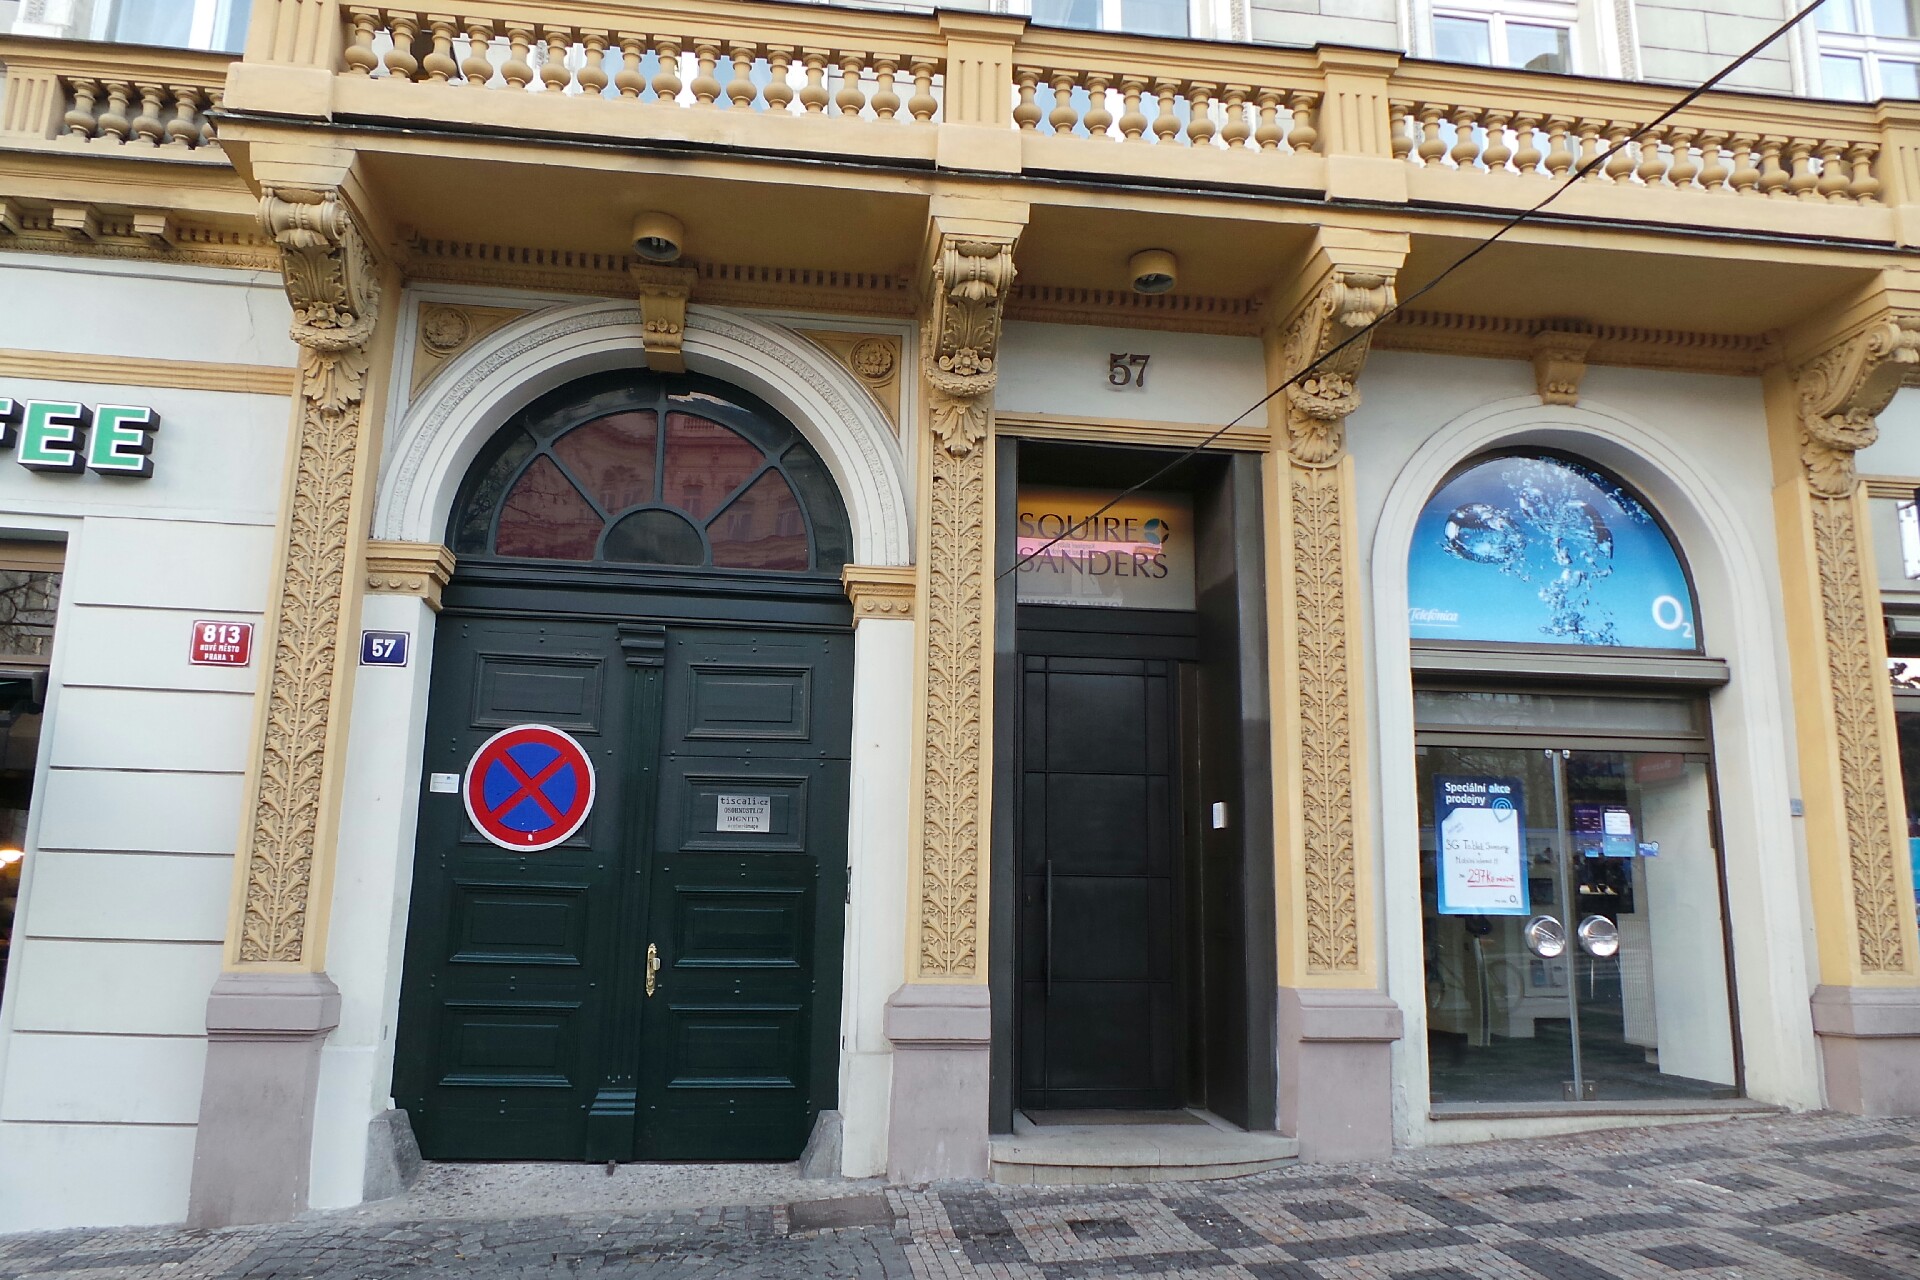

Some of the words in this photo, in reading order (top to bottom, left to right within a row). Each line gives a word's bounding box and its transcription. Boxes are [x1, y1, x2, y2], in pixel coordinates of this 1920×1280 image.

[1108, 352, 1151, 388] 57
[1019, 512, 1138, 545] SQUIRE
[1018, 546, 1169, 579] SANDERS
[1651, 595, 1693, 638] O2
[202, 624, 240, 644] 813
[204, 653, 226, 661] PRAHA
[229, 654, 235, 662] 1
[371, 638, 397, 658] 57
[1444, 782, 1486, 794] Speciální
[1488, 783, 1511, 794] akce
[720, 797, 768, 805] tiscali.cz
[1445, 793, 1486, 806] prodejny
